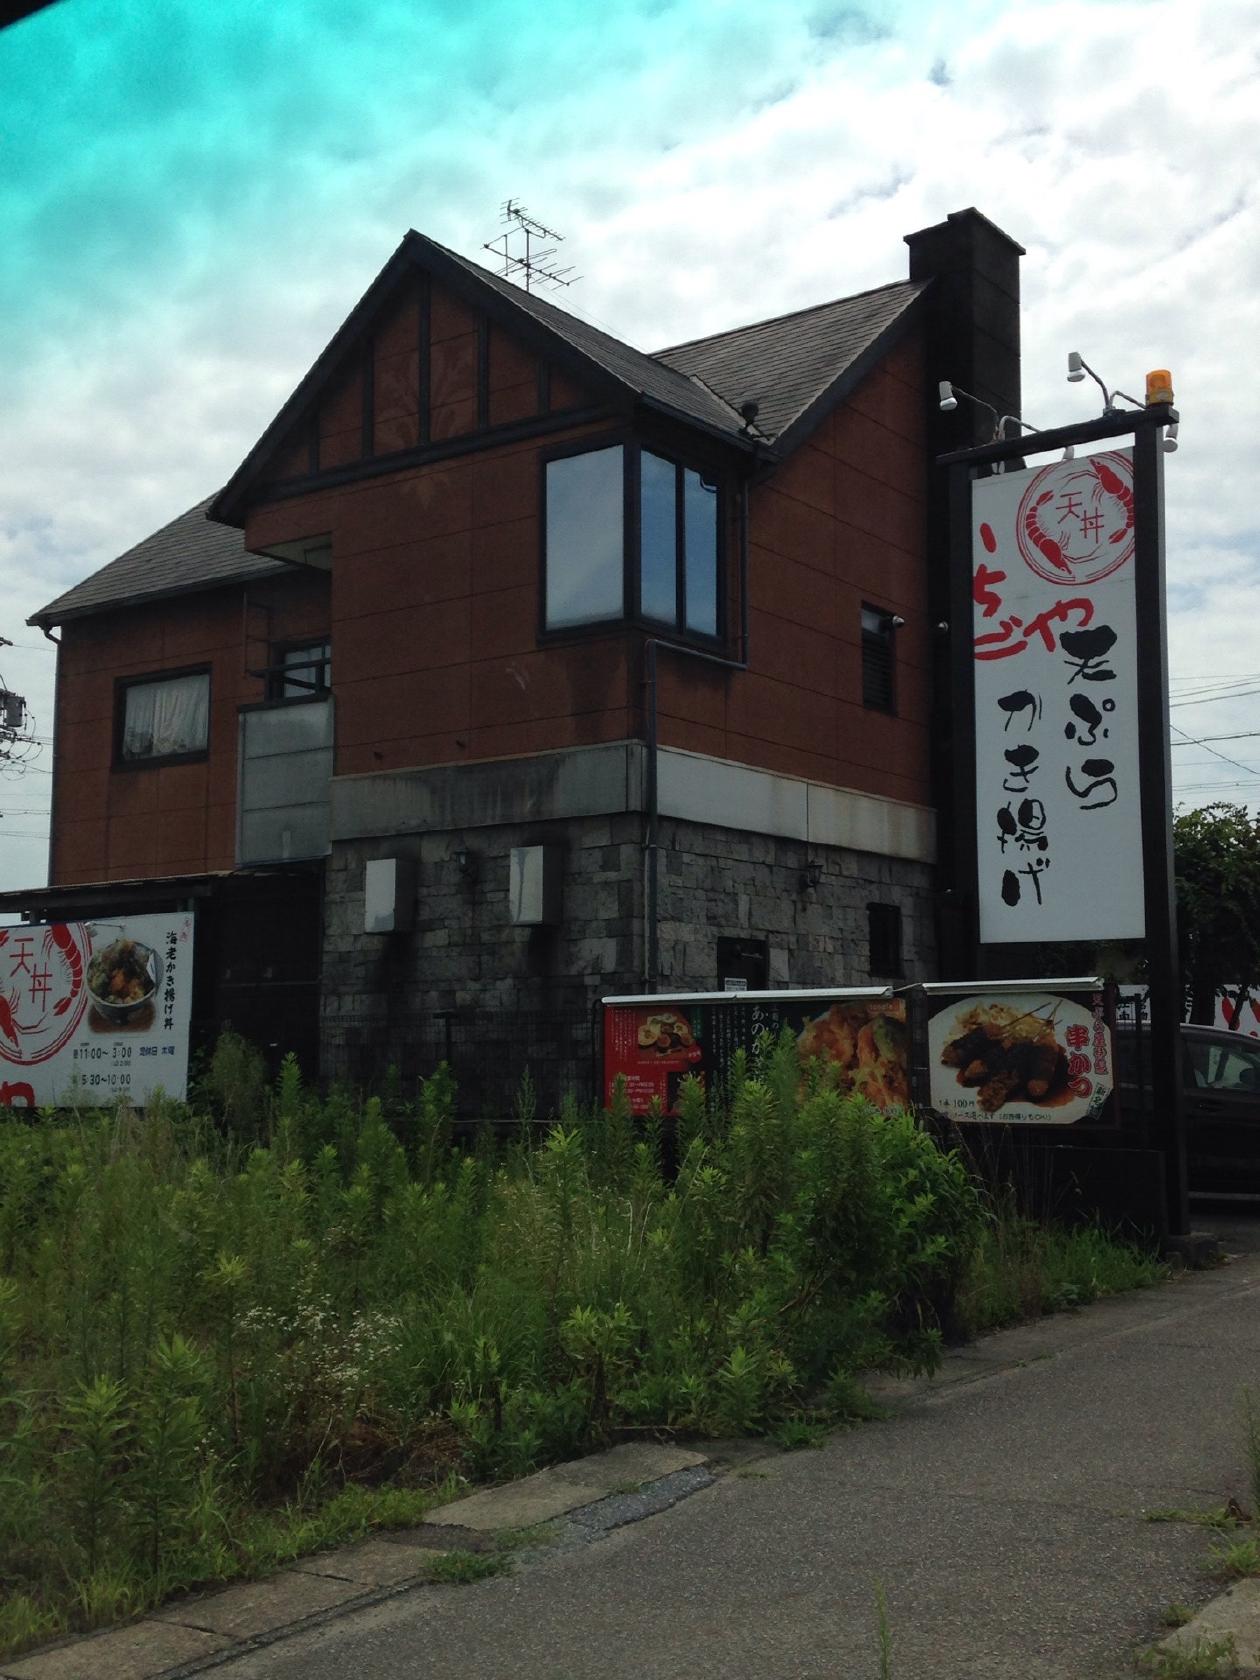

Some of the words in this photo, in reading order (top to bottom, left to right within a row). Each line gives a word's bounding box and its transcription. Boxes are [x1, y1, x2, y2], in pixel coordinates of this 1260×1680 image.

[1055, 491, 1105, 544] 天丼
[1059, 624, 1118, 811] 天ぷら
[995, 688, 1050, 907] かき揚げ
[9, 937, 53, 1013] 天丼
[162, 930, 178, 1031] 海老かき揚げ丼
[1066, 1024, 1093, 1099] 串かつ
